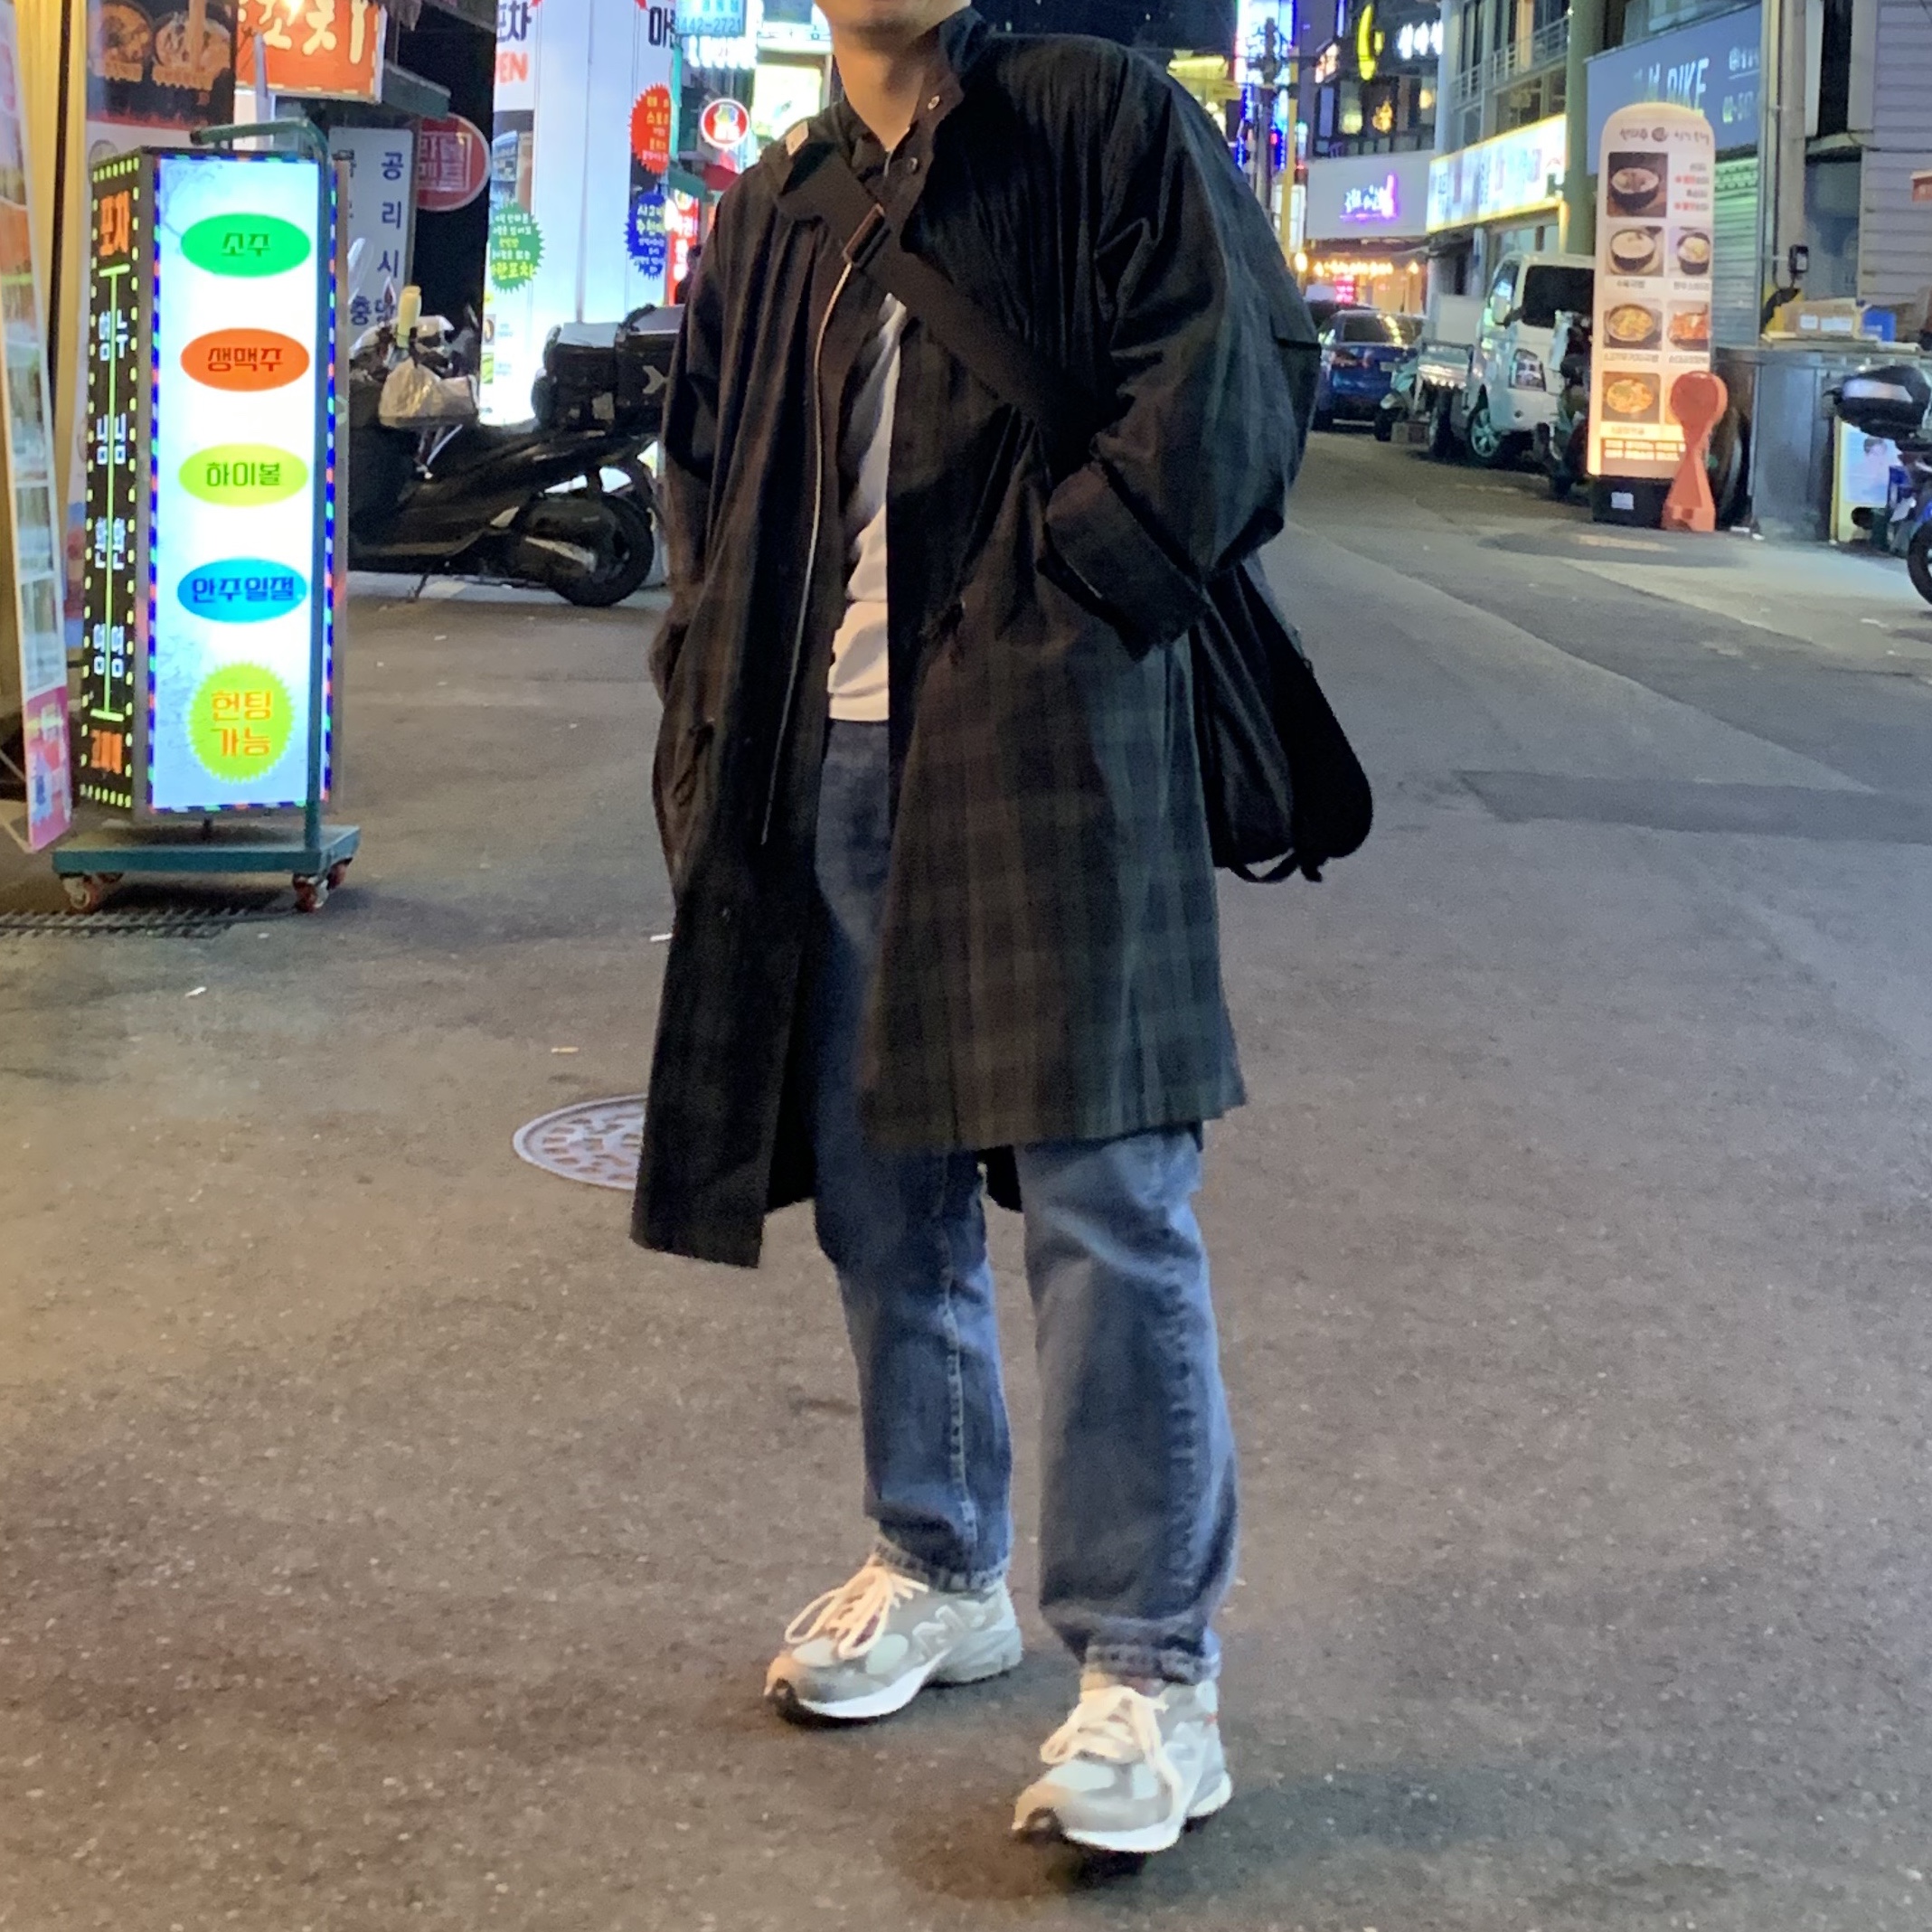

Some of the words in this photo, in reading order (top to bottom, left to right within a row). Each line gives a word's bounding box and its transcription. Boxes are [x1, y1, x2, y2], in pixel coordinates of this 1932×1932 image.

[221, 232, 271, 257] 소주
[208, 347, 284, 372] 생맥주
[206, 462, 280, 486] 하이볼
[211, 691, 271, 721] 헌팅
[211, 727, 271, 757] 가능
